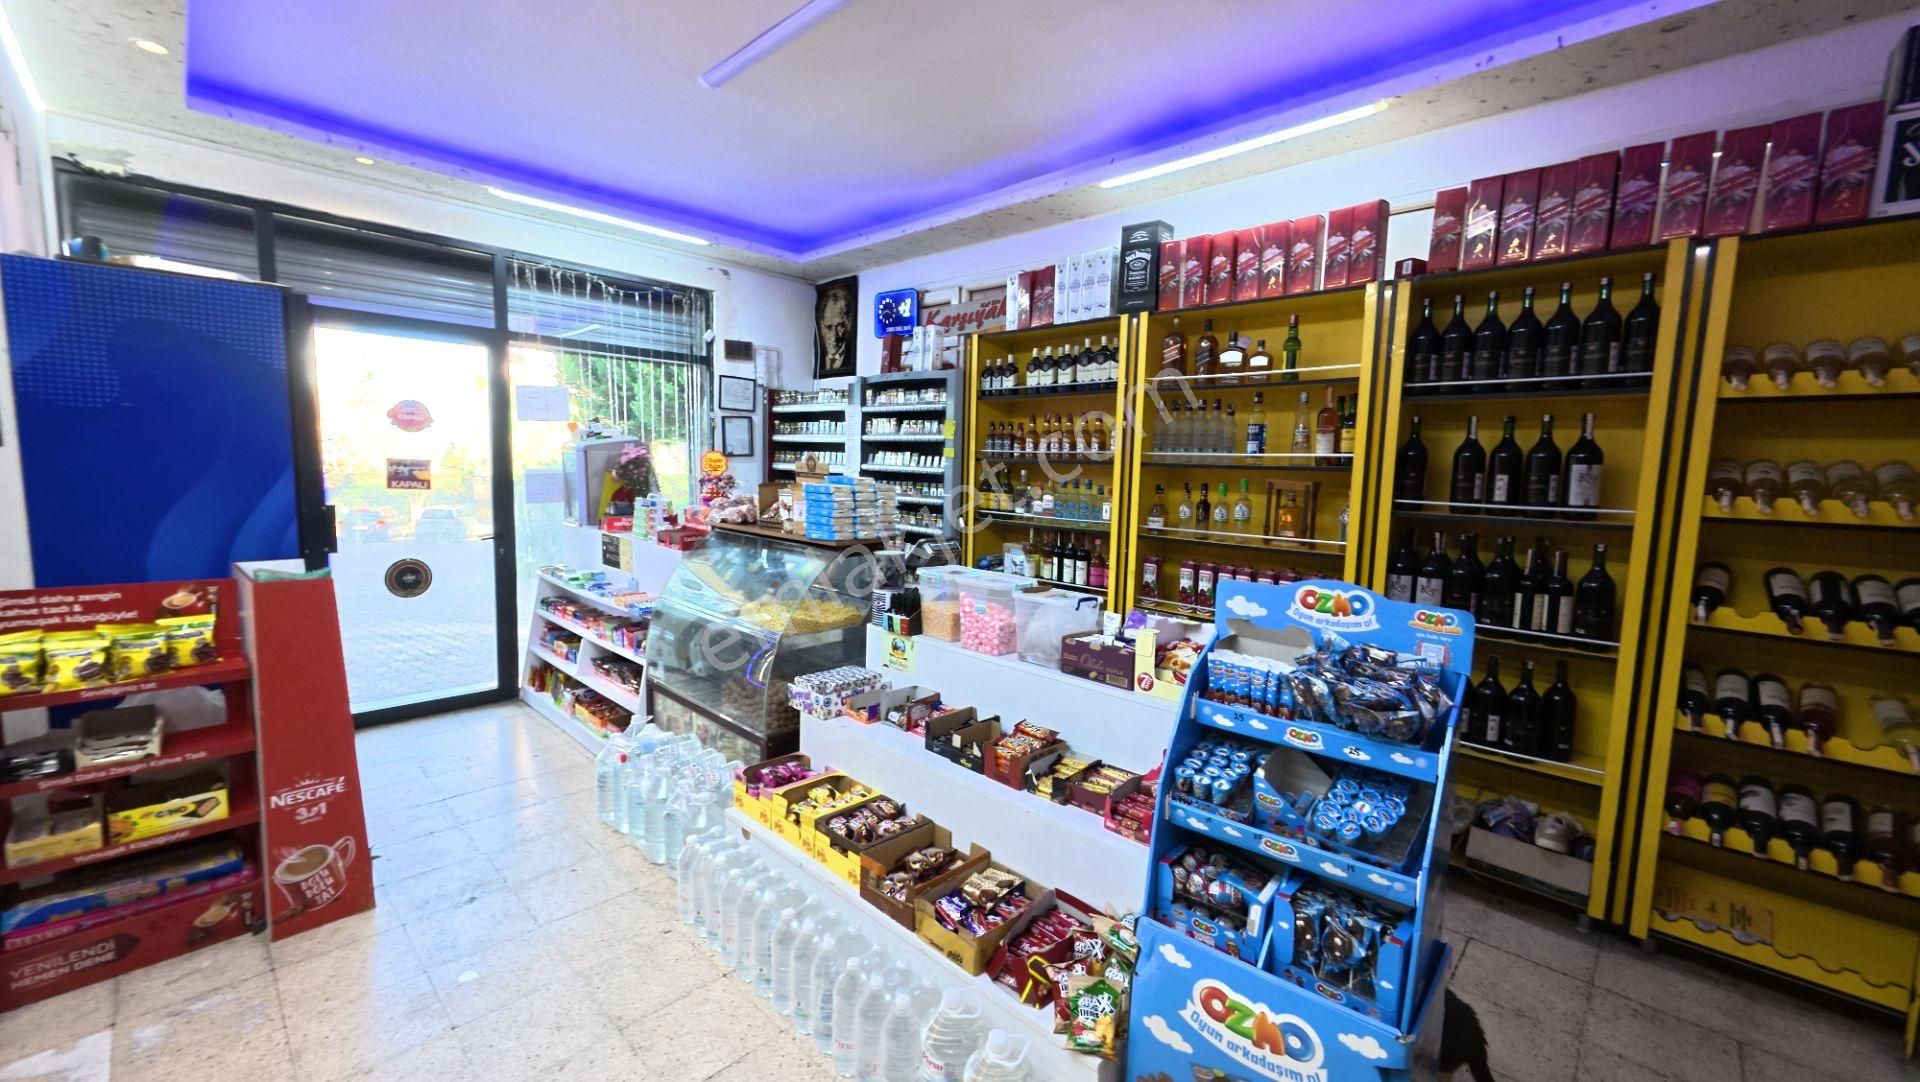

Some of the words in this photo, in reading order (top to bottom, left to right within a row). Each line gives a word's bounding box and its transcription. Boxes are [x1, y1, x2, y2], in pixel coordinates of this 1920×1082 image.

[391, 480, 428, 489] KAPALI
[1300, 589, 1370, 617] OZMO
[269, 776, 346, 809] NESCAFÉ
[10, 966, 70, 989] HEMEN
[74, 953, 116, 971] DENE
[1200, 986, 1315, 1063] OZMO
[1190, 1010, 1224, 1042] Oyun
[1226, 1040, 1303, 1082] arkadaşım
